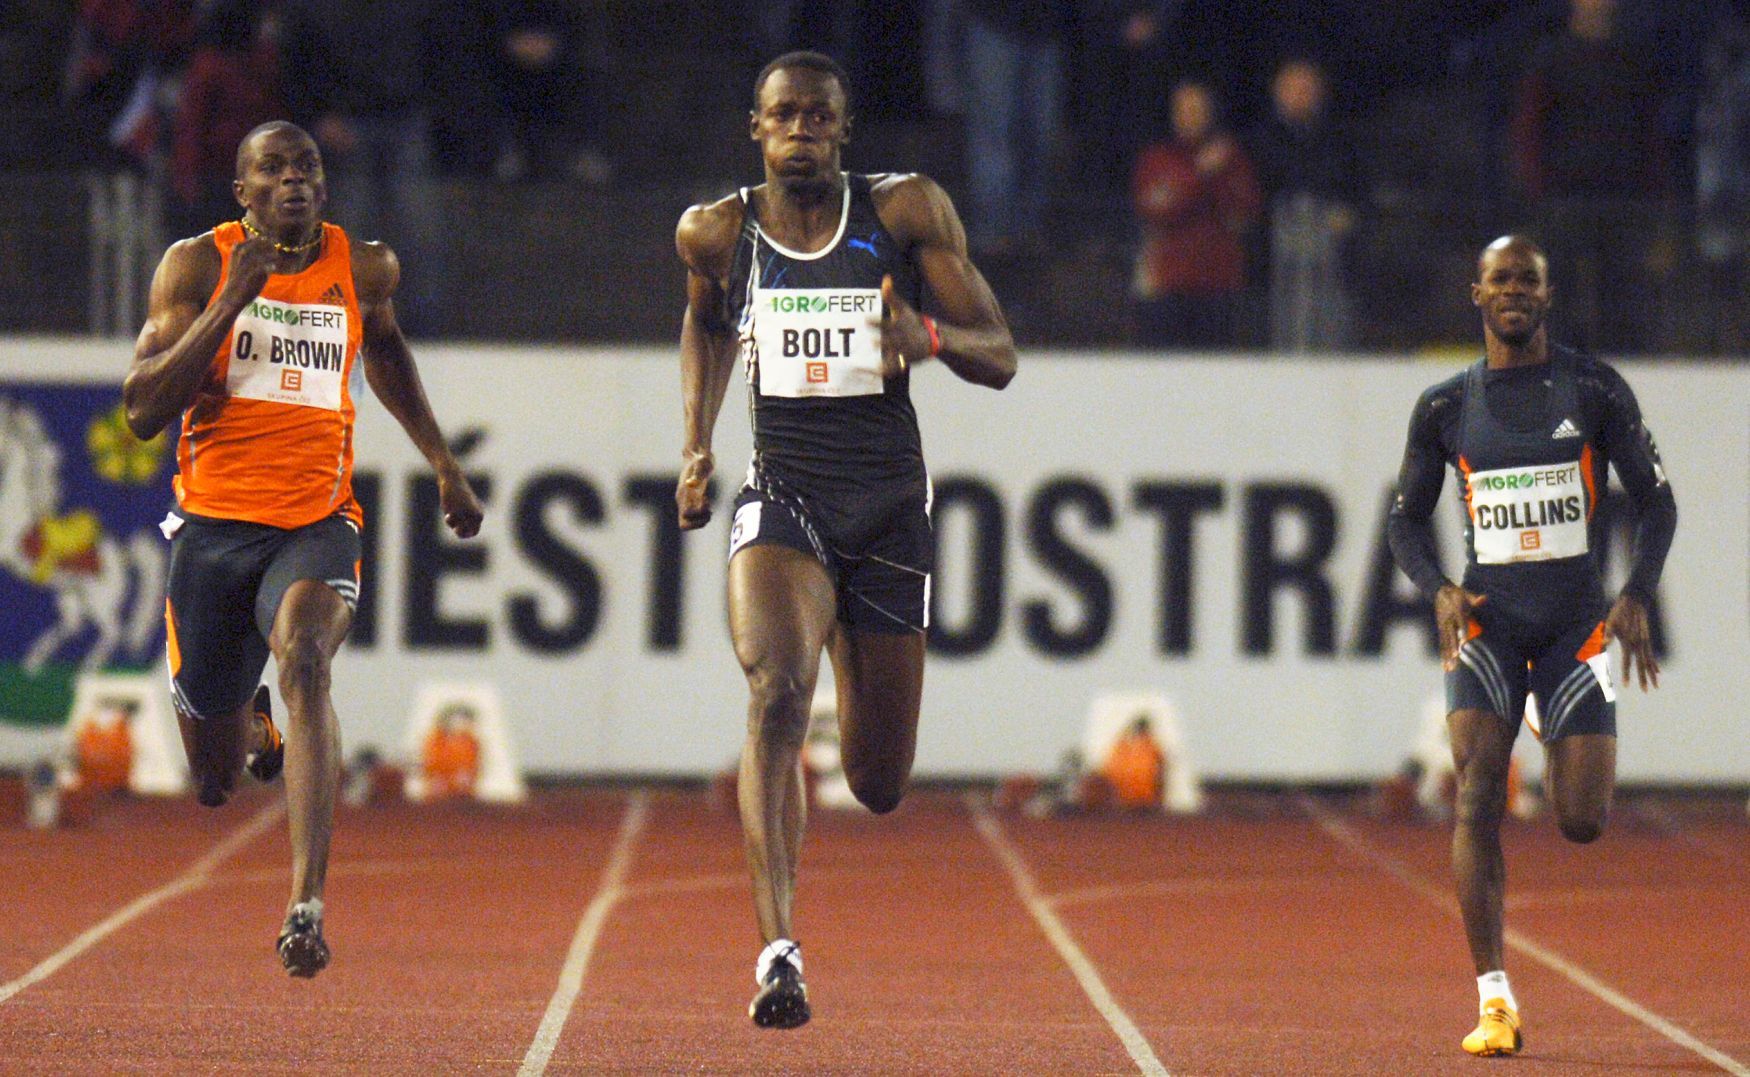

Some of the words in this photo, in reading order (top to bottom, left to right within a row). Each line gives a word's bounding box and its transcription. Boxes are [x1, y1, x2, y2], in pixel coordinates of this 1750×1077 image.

[236, 330, 258, 361] O.
[270, 335, 343, 372] BROWN
[782, 328, 856, 358] BOLT
[1477, 496, 1581, 530] COLLINS
